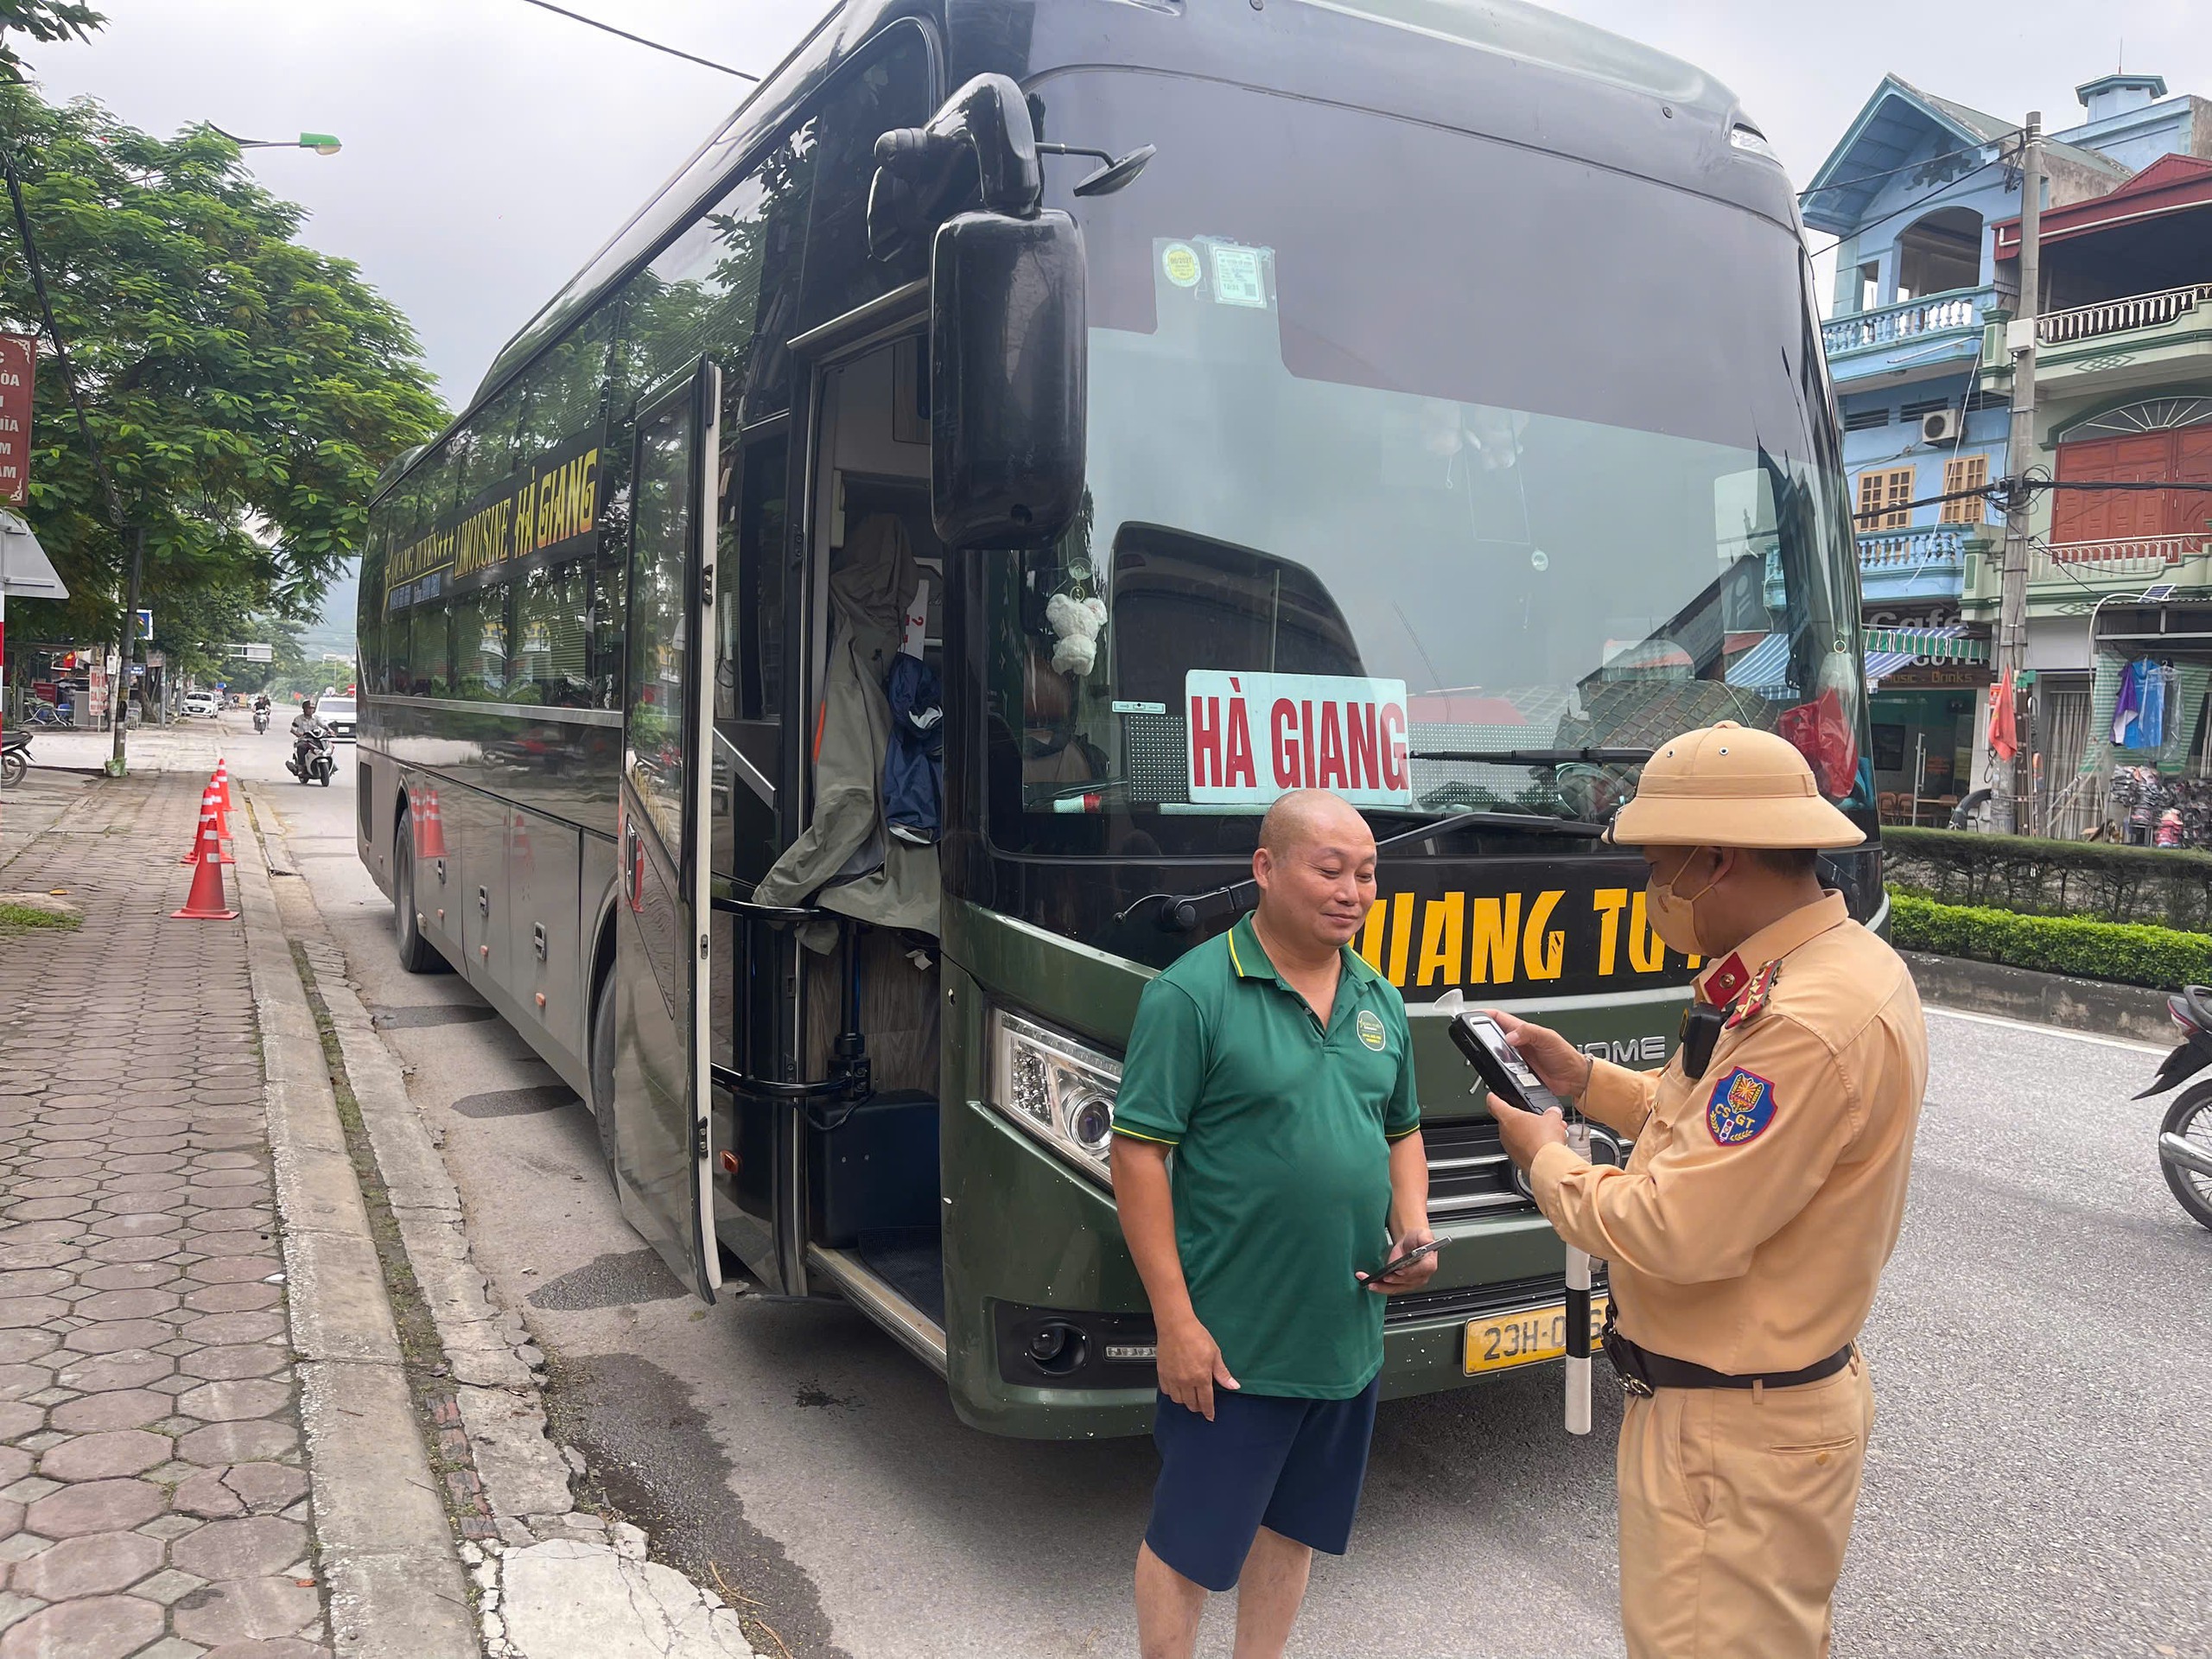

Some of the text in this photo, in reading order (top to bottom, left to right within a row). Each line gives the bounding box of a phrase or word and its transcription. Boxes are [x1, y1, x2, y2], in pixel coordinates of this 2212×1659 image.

[454, 498, 512, 579] LIMOUSINE
[537, 448, 598, 549] GIANG
[1191, 677, 1409, 791] HÀ GIANG
[1350, 890, 1567, 987] UANG
[1577, 1036, 1665, 1063] OME
[1714, 1103, 1756, 1128] CS GT
